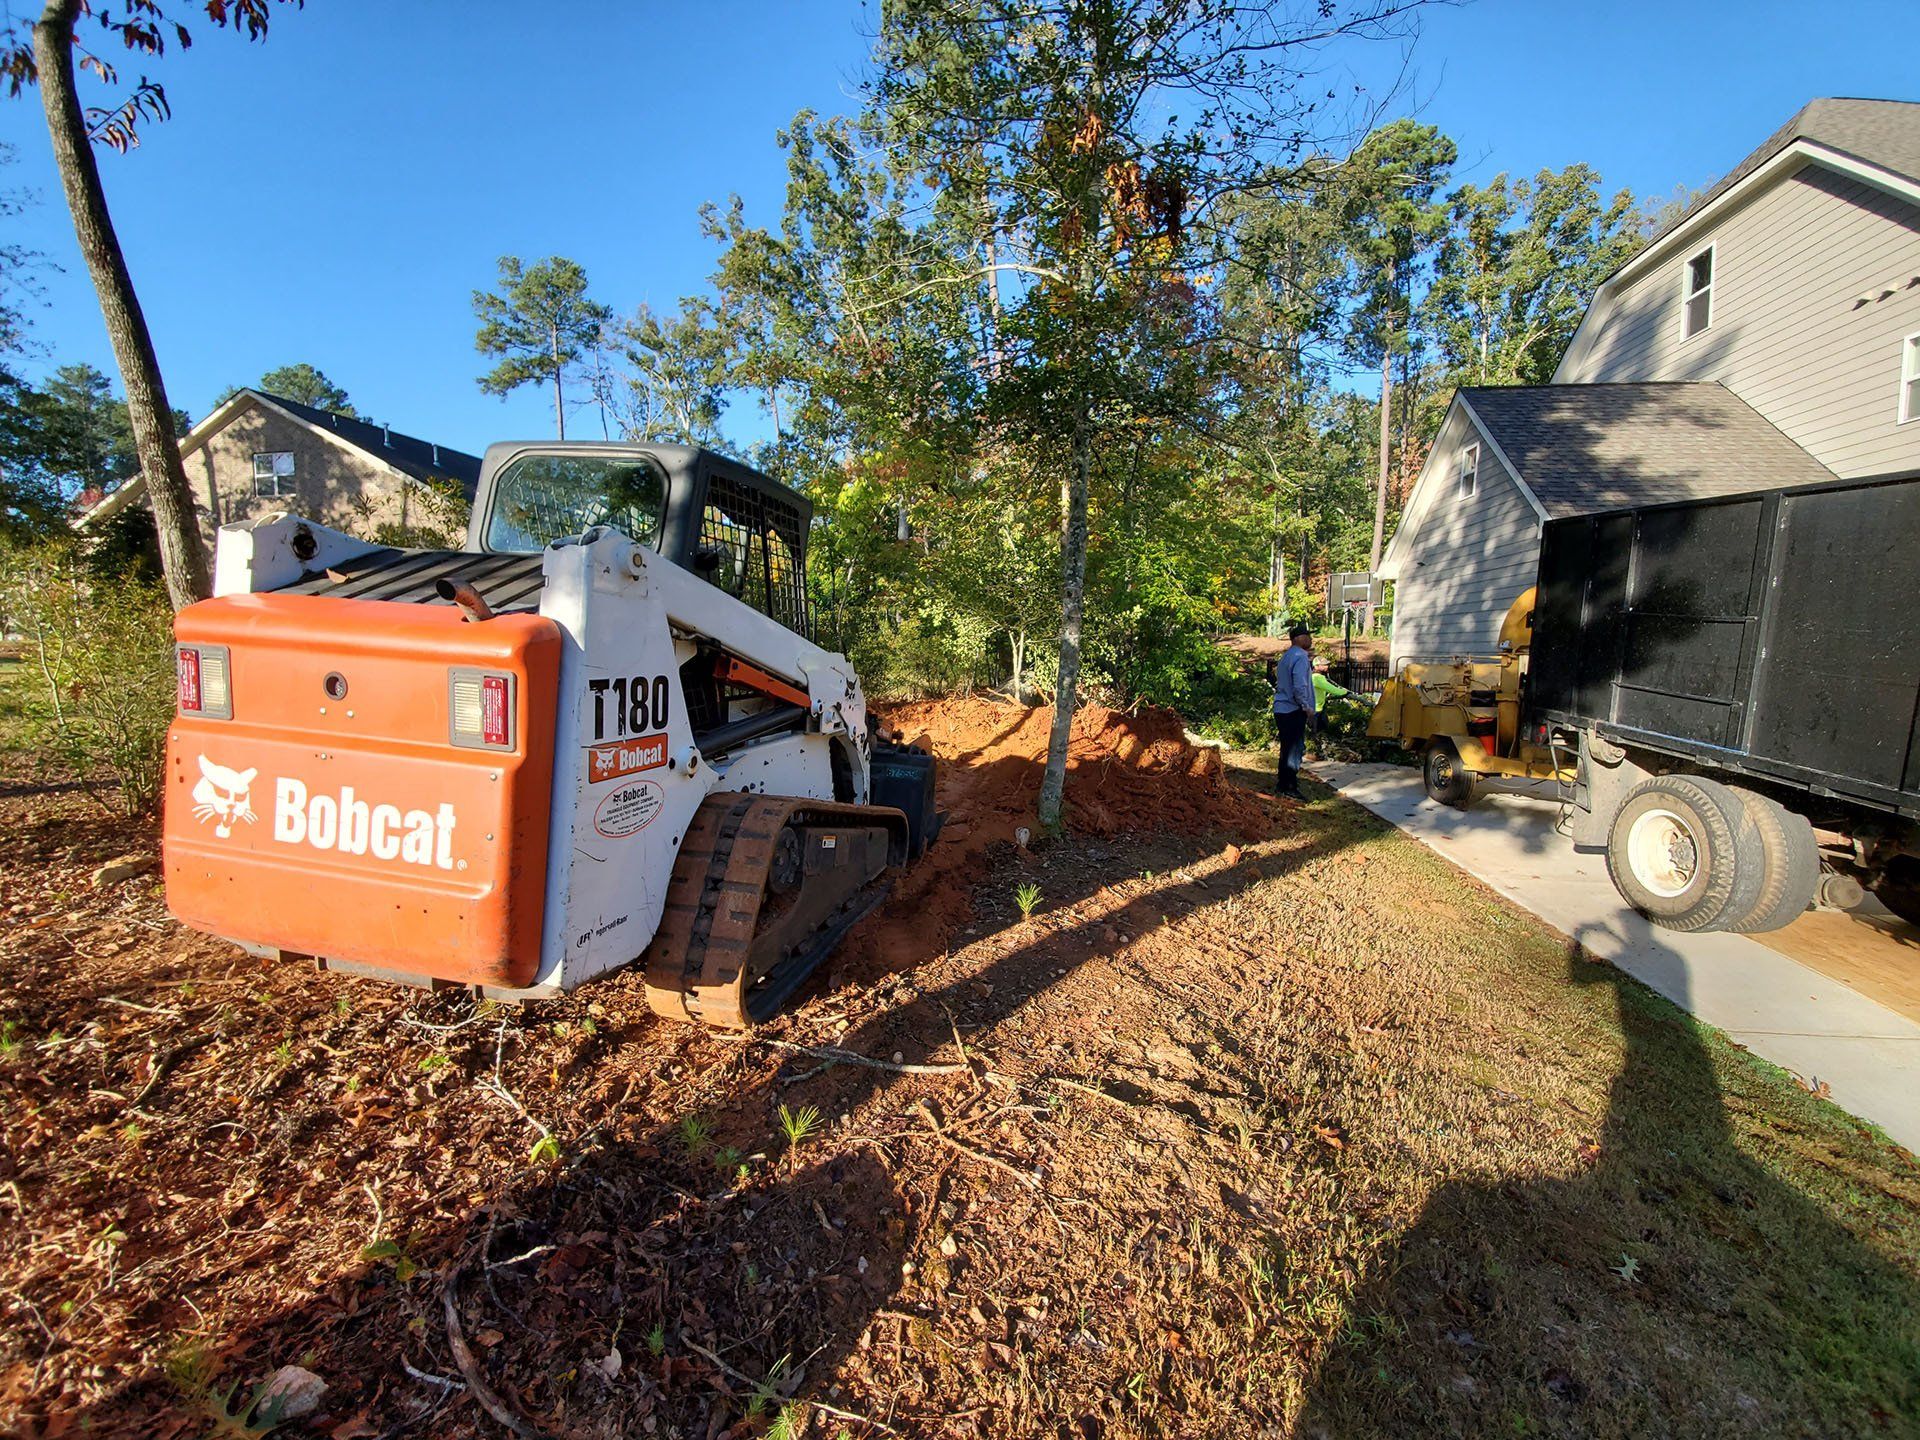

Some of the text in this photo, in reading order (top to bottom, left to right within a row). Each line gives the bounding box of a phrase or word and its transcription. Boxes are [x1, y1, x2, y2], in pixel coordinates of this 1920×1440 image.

[589, 675, 669, 740] T180
[619, 742, 662, 771] Bobcat
[623, 784, 647, 802] Bobcat
[274, 777, 456, 870] Bobcat
